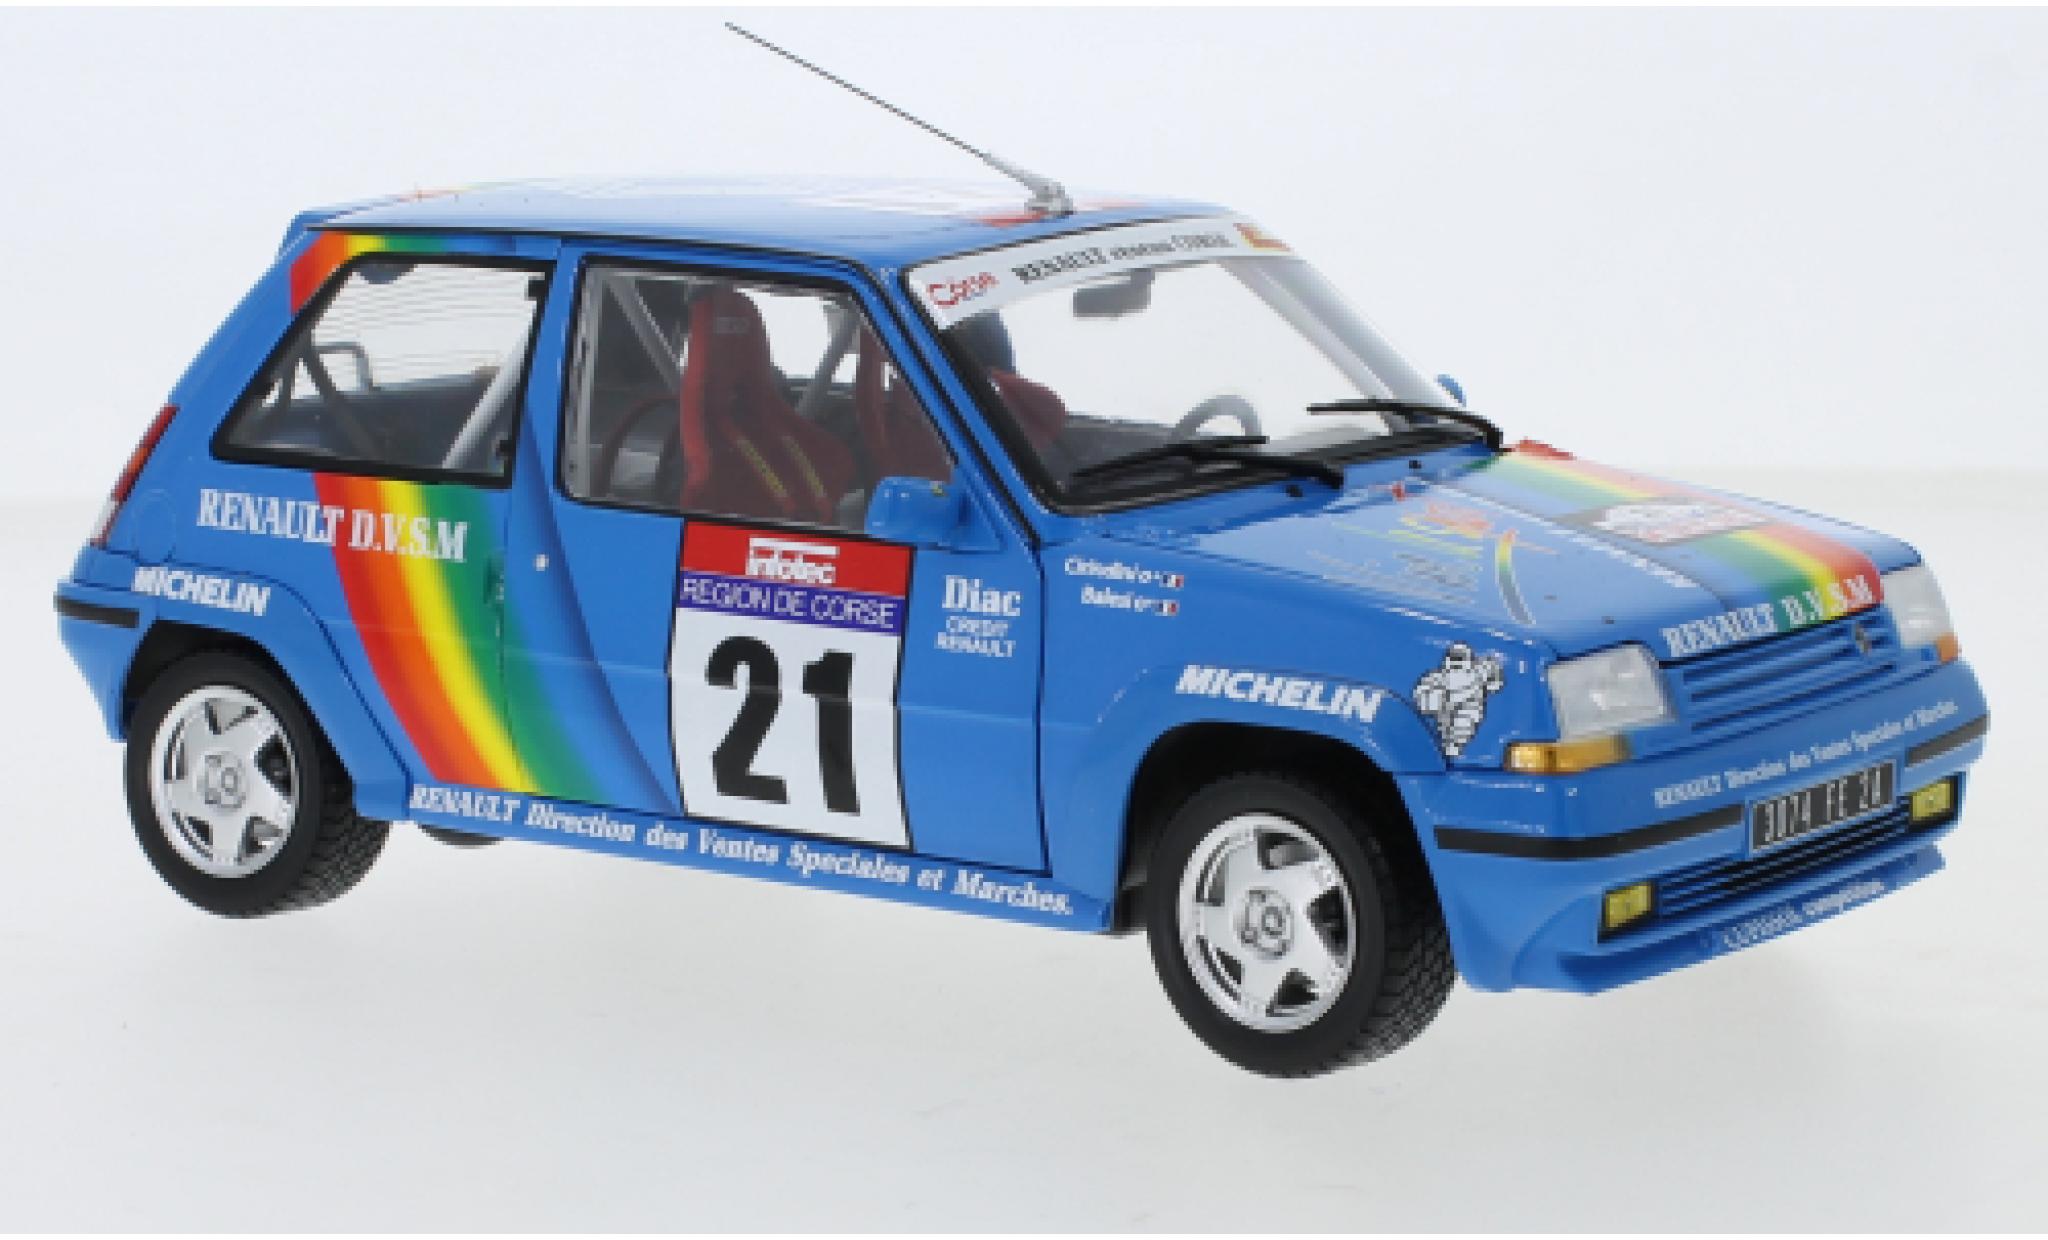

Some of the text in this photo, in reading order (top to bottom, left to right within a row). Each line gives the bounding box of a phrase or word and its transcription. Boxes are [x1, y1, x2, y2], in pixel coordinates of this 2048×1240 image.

[197, 488, 469, 561] RENAULT D.V.S.M
[132, 566, 271, 616] MICHELIN
[745, 548, 837, 585] infotec
[681, 577, 898, 629] REGION DE CORSE
[941, 574, 1022, 618] Diac
[1659, 575, 1875, 658] RENAULT D.V.S.M
[934, 631, 1017, 659] RENAULT
[1175, 664, 1383, 723] MICHELIN
[706, 636, 860, 816] 21
[409, 785, 519, 825] RENAULT
[525, 803, 635, 844] Direction
[645, 820, 689, 849] des
[698, 828, 779, 868] Ventes
[786, 844, 910, 887] Speciales
[915, 866, 944, 892] et
